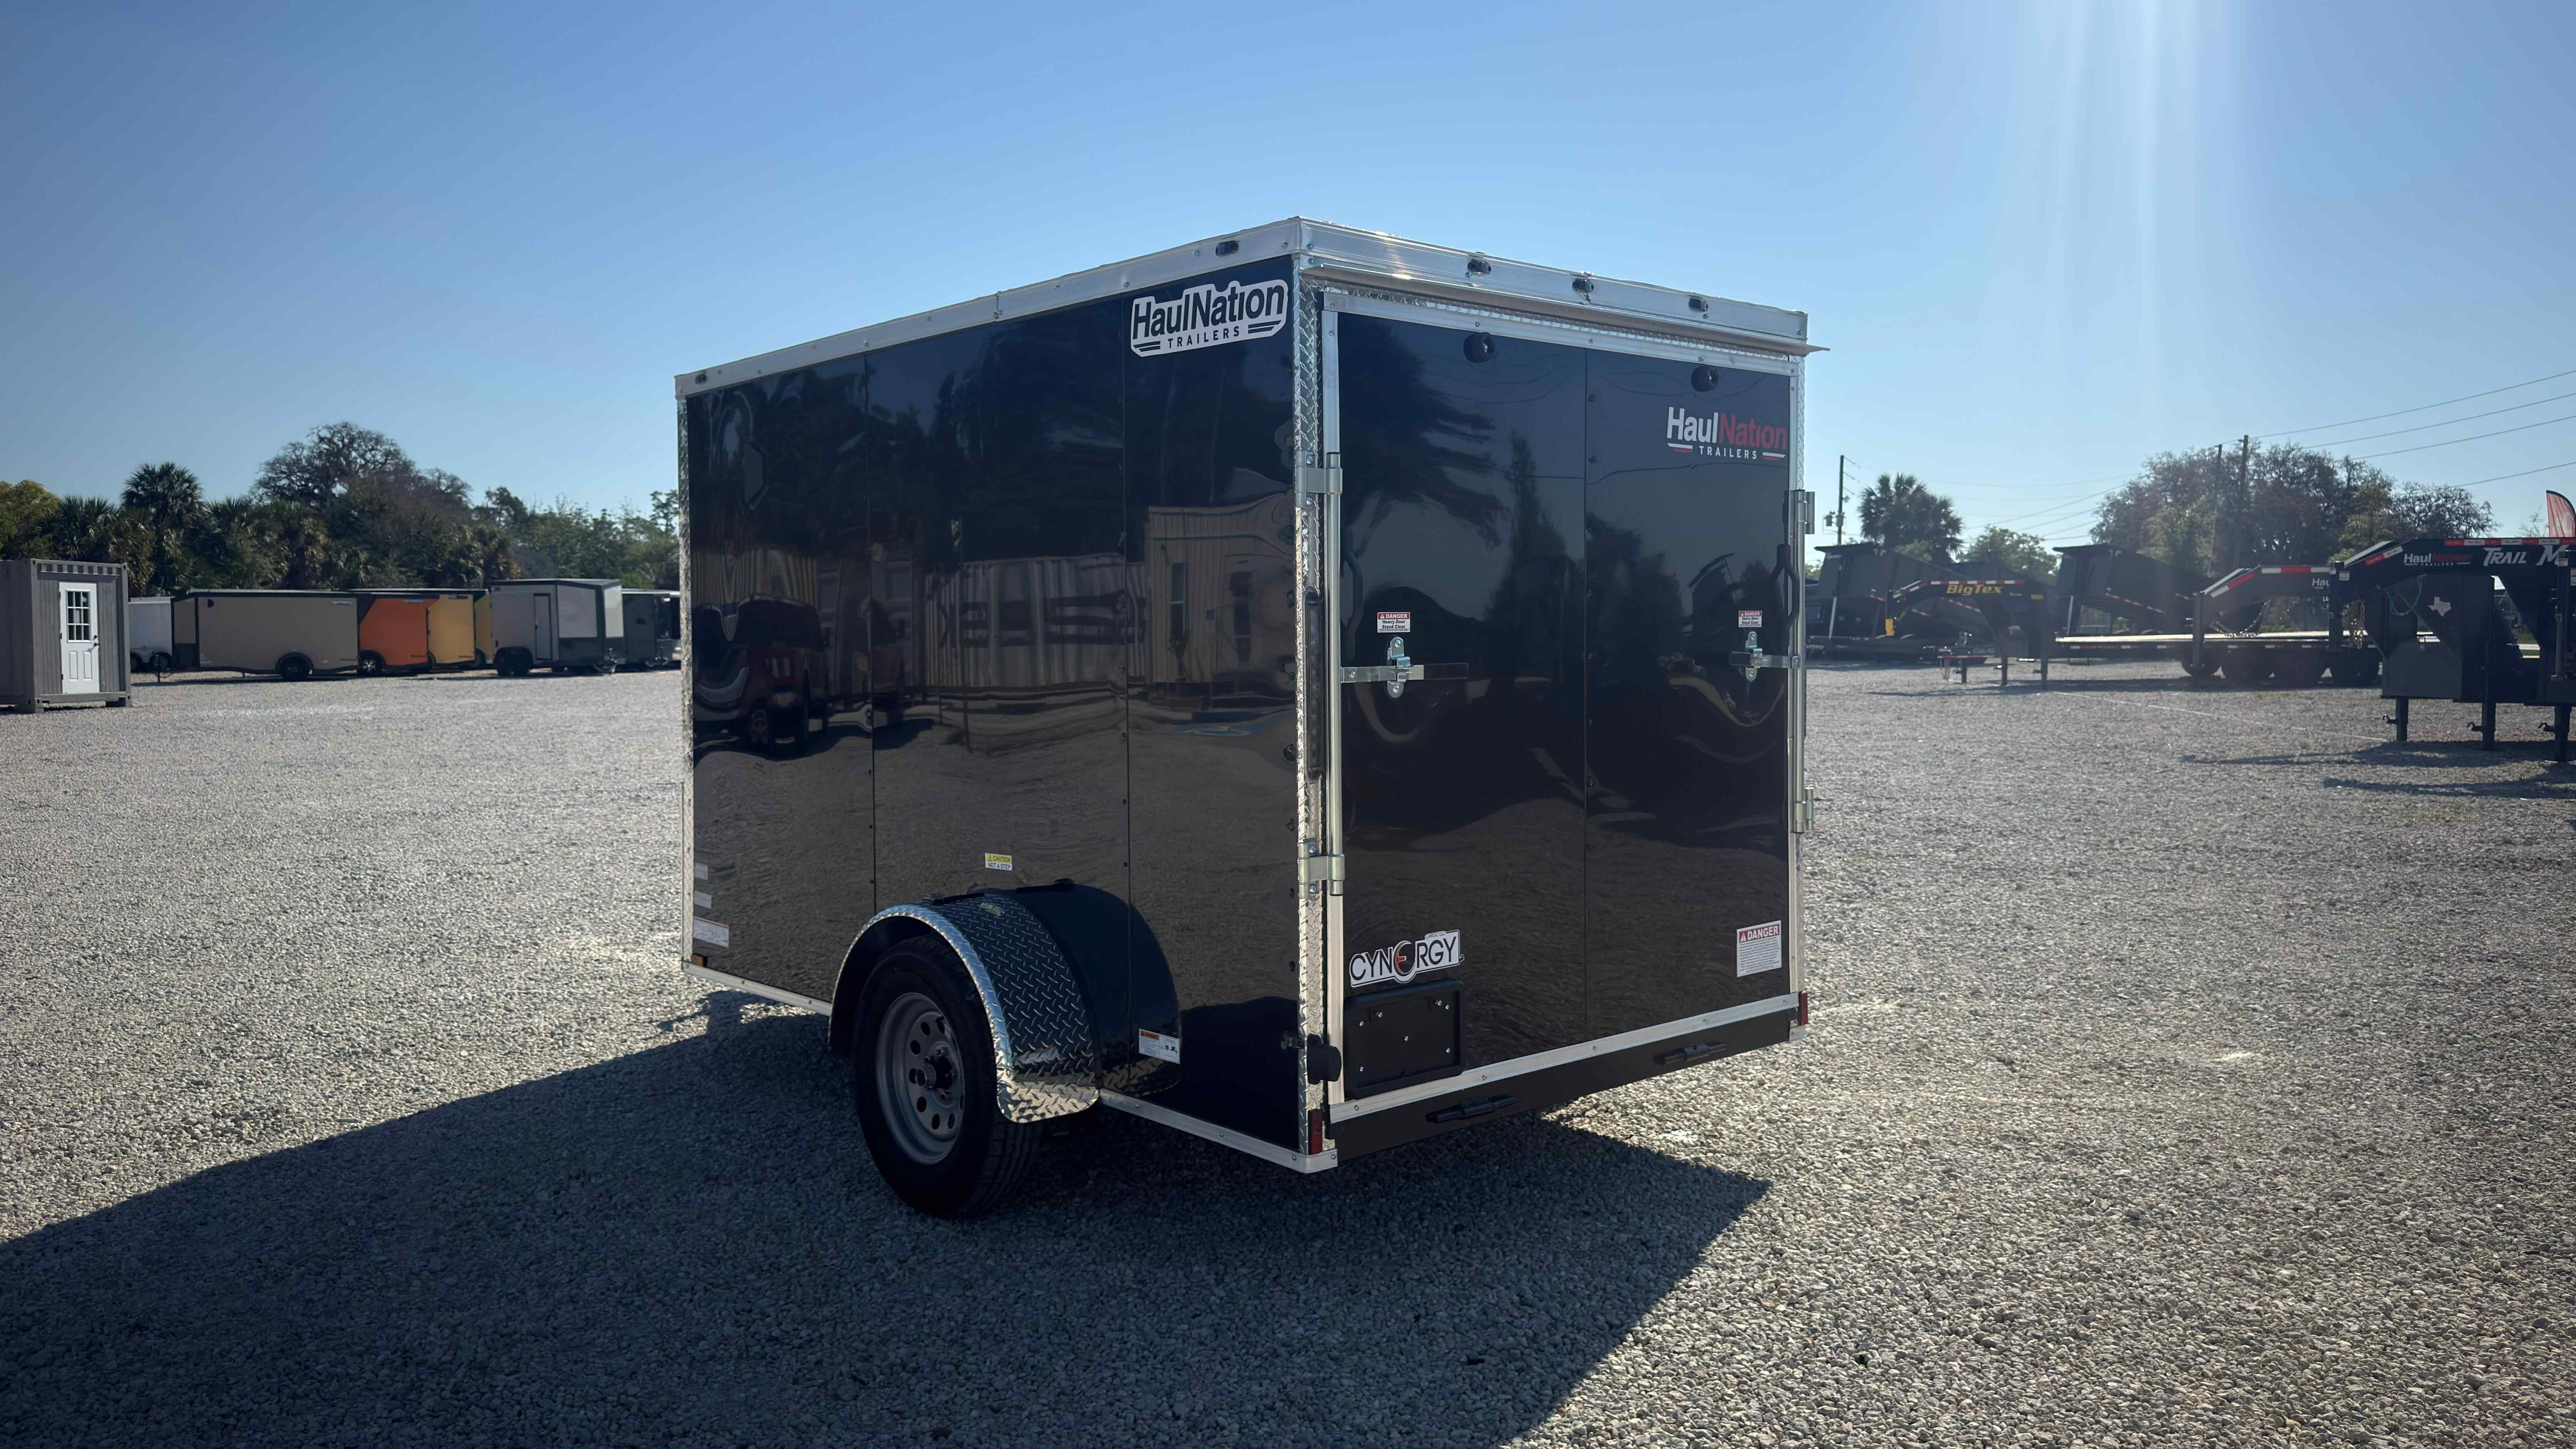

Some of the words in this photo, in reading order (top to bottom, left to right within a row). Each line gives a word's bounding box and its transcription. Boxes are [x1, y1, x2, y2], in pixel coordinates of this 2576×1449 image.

[1132, 285, 1285, 340] HaulNation
[1167, 326, 1239, 349] TRAILERS
[1667, 406, 1787, 450] HaulNation
[1699, 446, 1757, 460] TRAILERS
[2483, 547, 2527, 567] TRAIL
[1747, 925, 1778, 941] DANGER
[1350, 936, 1457, 981] CYNERGY
